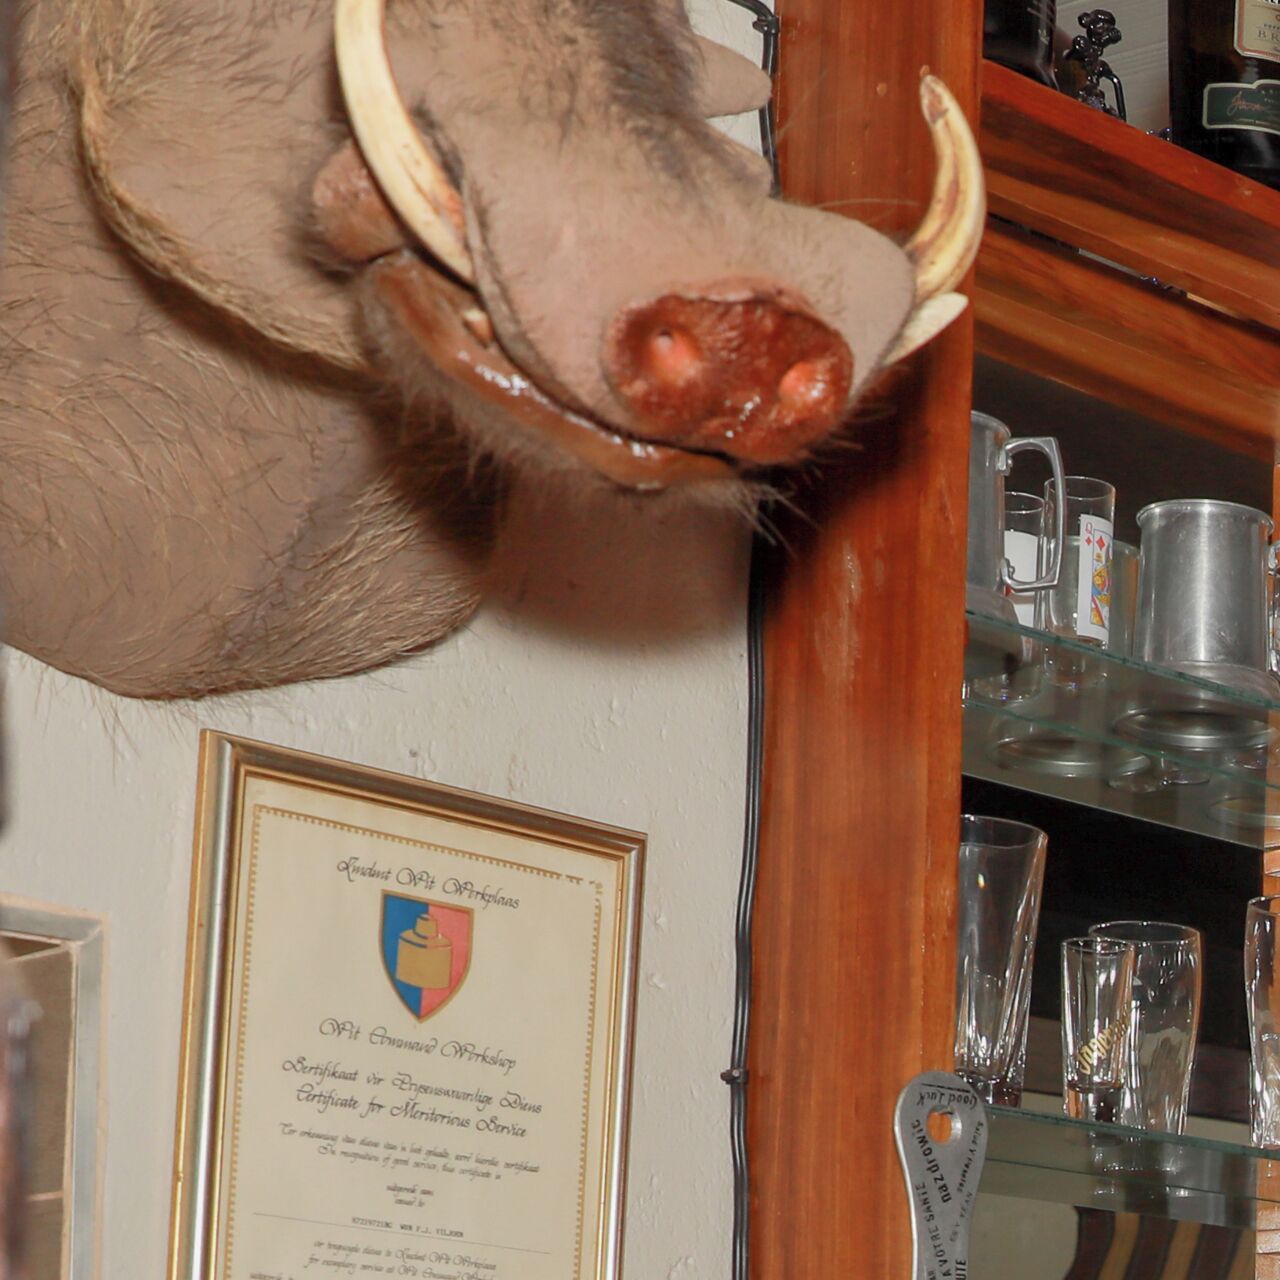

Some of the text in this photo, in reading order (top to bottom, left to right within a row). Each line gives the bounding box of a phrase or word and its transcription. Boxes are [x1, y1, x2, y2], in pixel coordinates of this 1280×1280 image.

[1084, 522, 1094, 535] Q
[396, 866, 437, 891] Wit
[319, 1017, 517, 1076] Wit Command Workshop
[281, 1055, 359, 1086] Sertifikaat
[366, 1071, 385, 1087] vir
[499, 1089, 543, 1115] Diens
[946, 1089, 979, 1110] Good
[295, 1082, 528, 1139] Certificate for Meritorious Service
[927, 1223, 950, 1270] VOTRE
